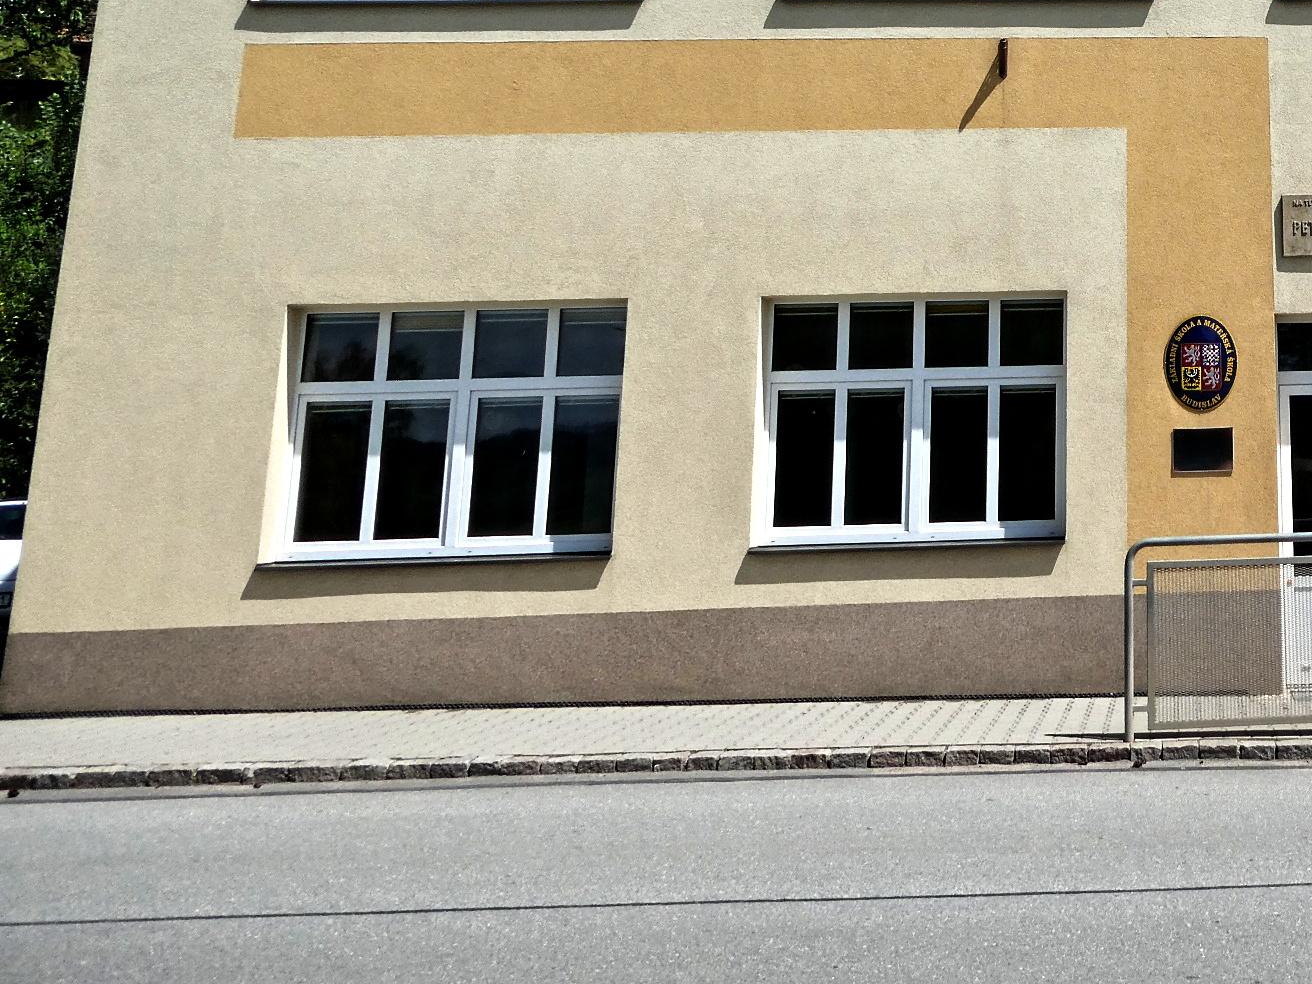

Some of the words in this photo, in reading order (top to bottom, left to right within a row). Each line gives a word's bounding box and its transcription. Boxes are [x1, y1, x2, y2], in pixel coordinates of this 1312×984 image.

[1203, 319, 1234, 355] MATEŘSKÁ
[1224, 356, 1235, 382] ŠKOLA
[1181, 394, 1221, 408] BUDISLAV
